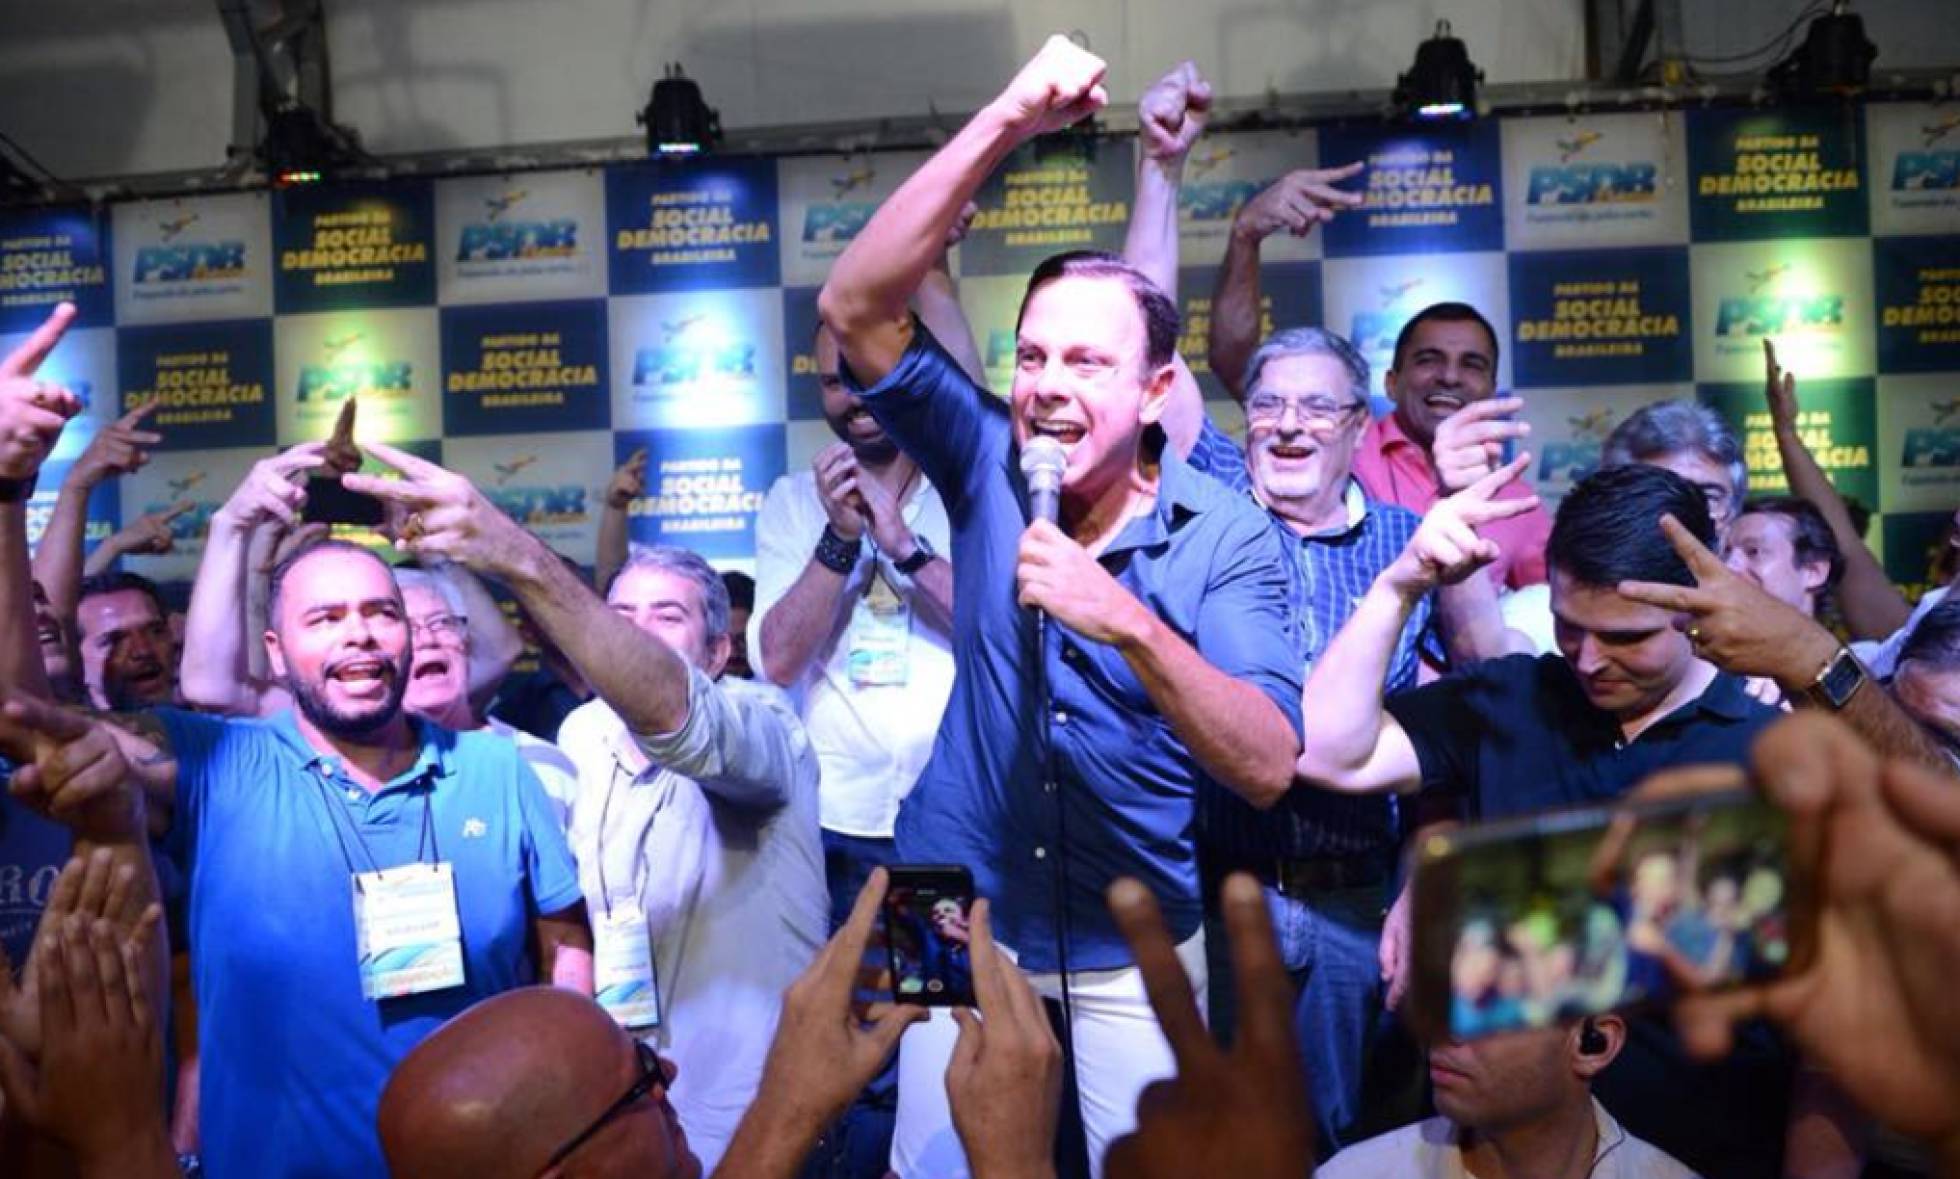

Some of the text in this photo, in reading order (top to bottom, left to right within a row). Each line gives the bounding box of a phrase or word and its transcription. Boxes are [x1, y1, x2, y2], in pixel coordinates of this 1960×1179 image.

[1735, 135, 1819, 150] PARTIDO DA
[1736, 152, 1822, 174] SOCIAL
[1368, 166, 1456, 189] SOCIAL
[1700, 170, 1858, 195] DEMOCRACIA
[1006, 186, 1090, 207] SOCIAL
[1363, 185, 1493, 209] MOCRACIA
[652, 207, 733, 227] SOCIAL
[971, 203, 1127, 229] DEMOCRACIA
[314, 227, 391, 249] SOCIAL
[617, 223, 770, 249] DEMOCRACIA
[3, 252, 74, 271] SOCIAL
[282, 243, 425, 270] DEMOCRACIA
[1555, 298, 1640, 319] SOCIAL
[1518, 315, 1679, 341] DEMOCRACIA
[482, 349, 561, 370] SOCIAL
[156, 367, 230, 388] SOCIAL
[448, 366, 597, 392] DEMOCRACIA
[125, 383, 263, 409] DEMOCRACIA
[661, 457, 742, 473] PARTIDO DA
[661, 474, 744, 495] SOCIAL
[628, 492, 763, 517] DEMOCRACI
